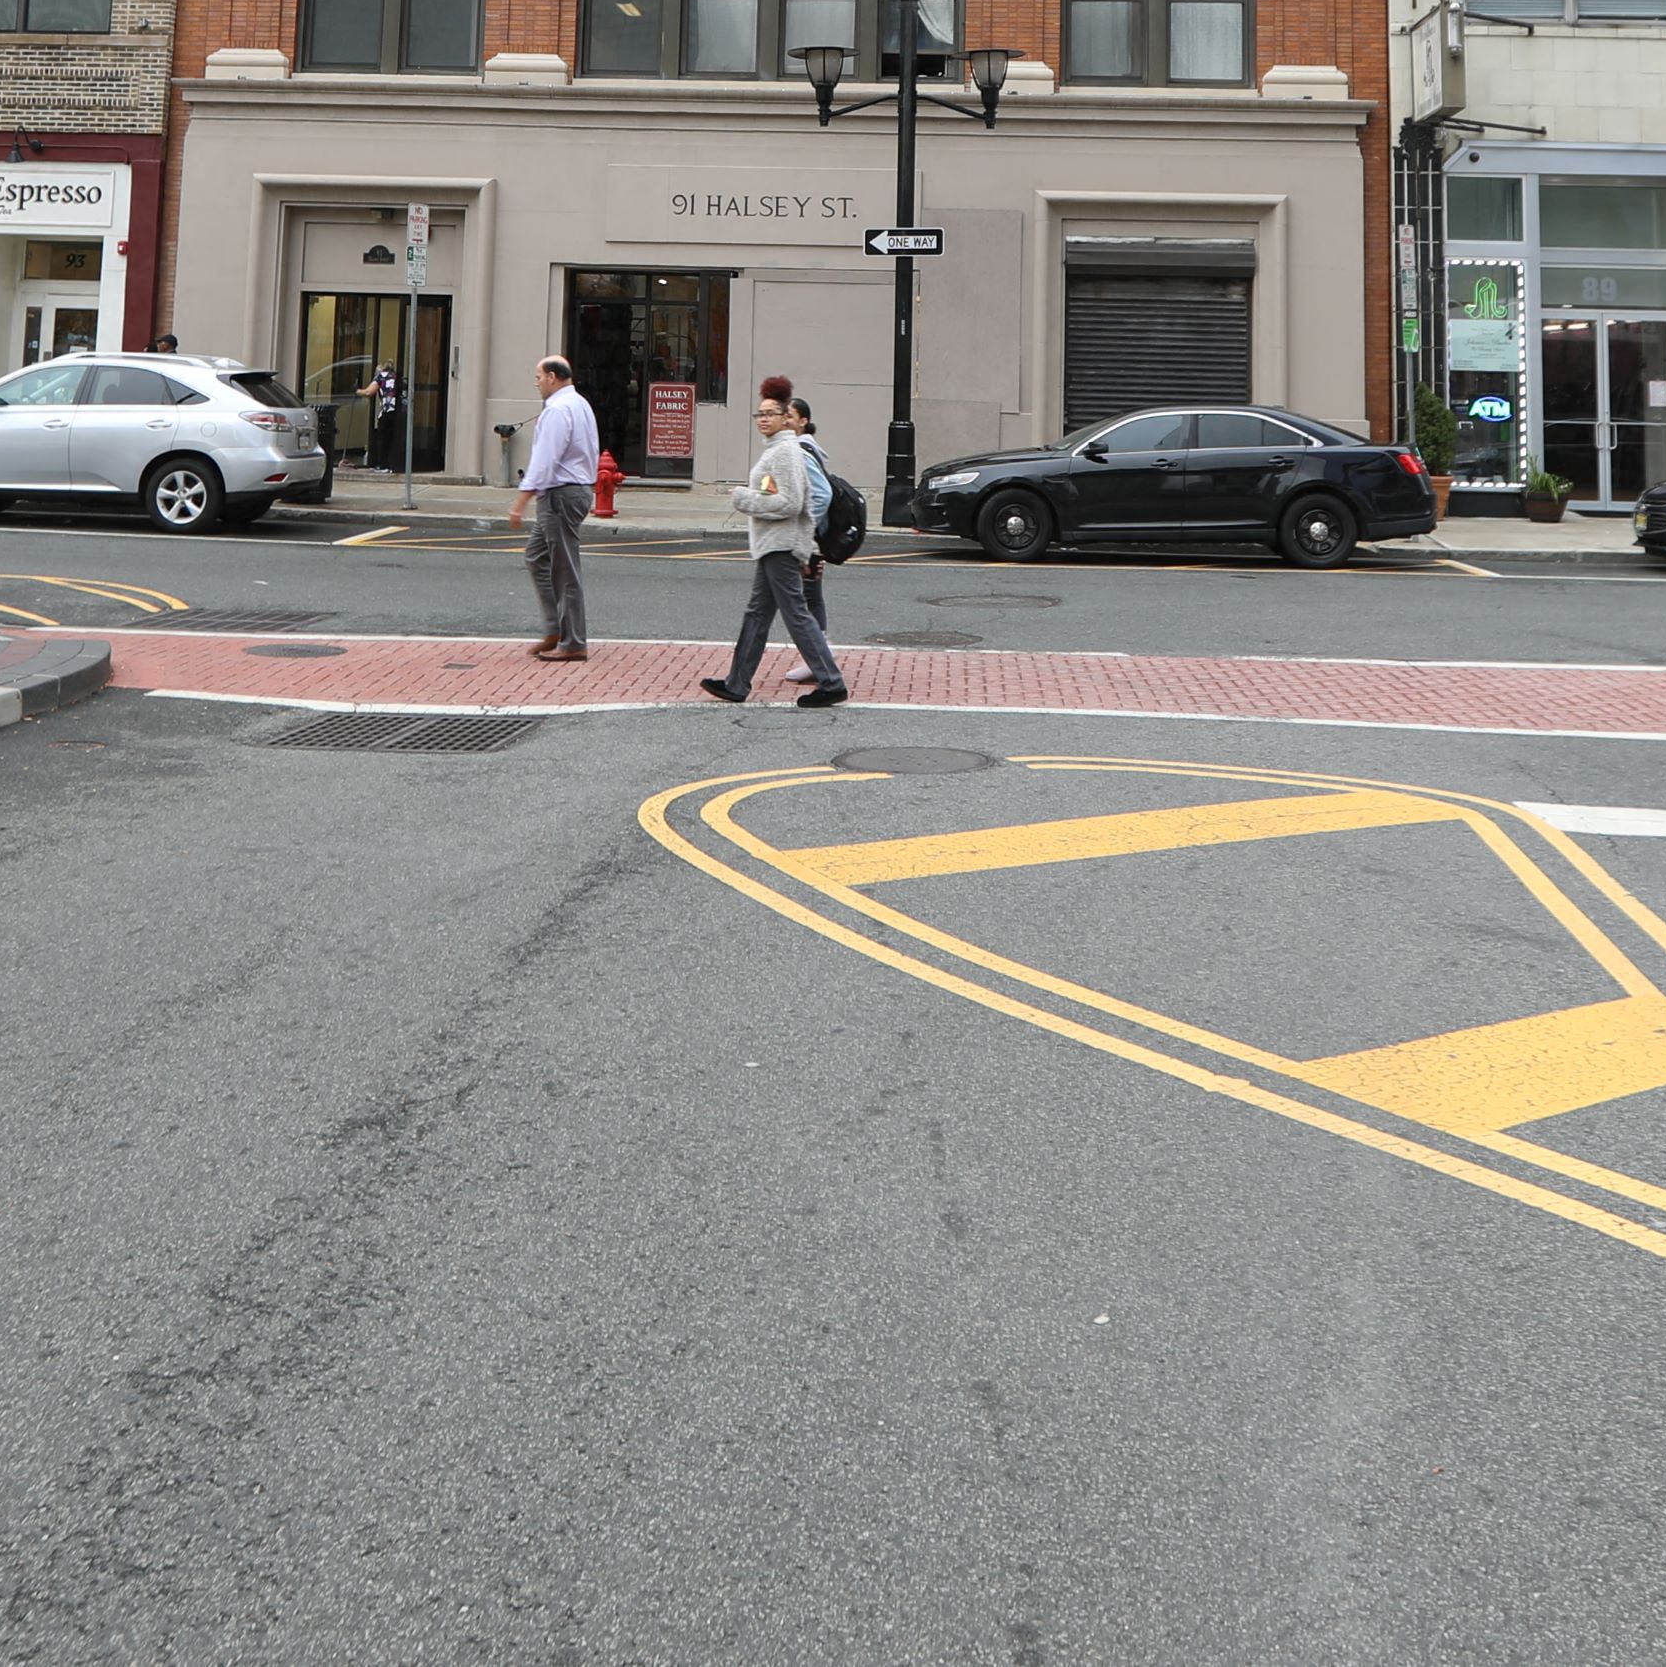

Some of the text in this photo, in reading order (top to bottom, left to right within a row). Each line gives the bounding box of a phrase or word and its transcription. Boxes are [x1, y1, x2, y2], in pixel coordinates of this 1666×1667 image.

[672, 194, 858, 219] 91 HALSEY ST.
[888, 236, 935, 248] ONE WAY
[64, 254, 86, 269] 93
[1583, 277, 1617, 302] 89
[655, 390, 689, 399] HALSEY
[655, 402, 689, 410] FABRIC
[1469, 401, 1511, 417] ATM
